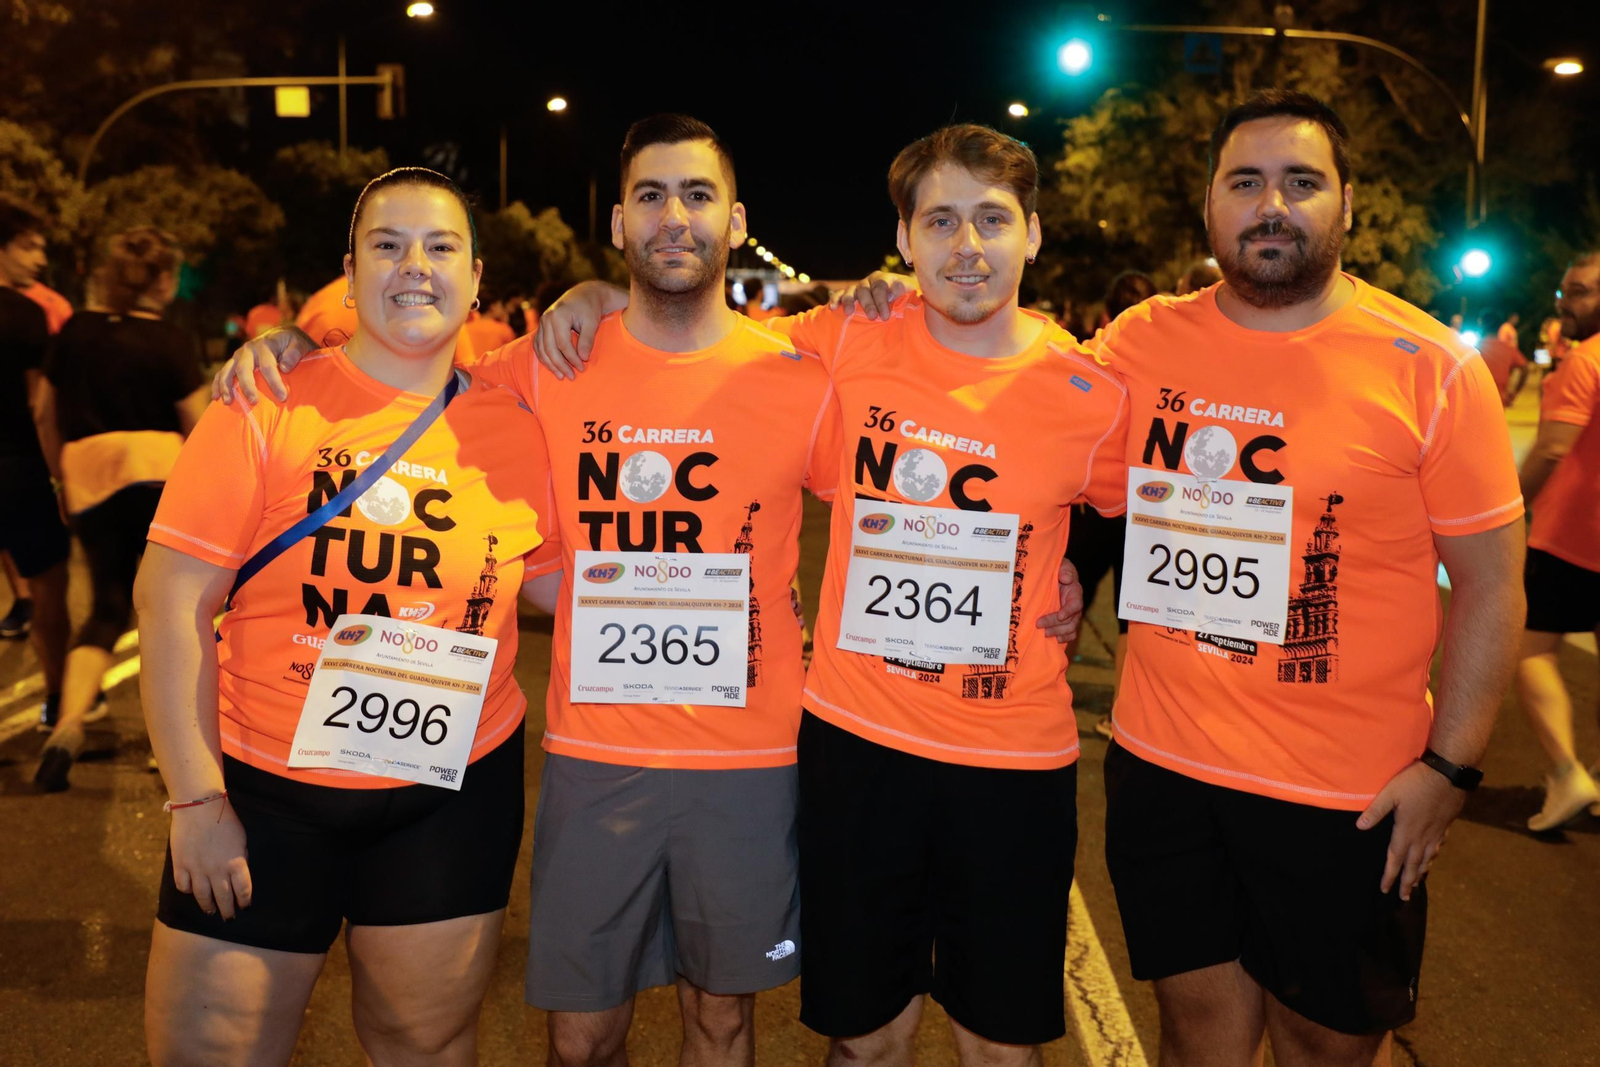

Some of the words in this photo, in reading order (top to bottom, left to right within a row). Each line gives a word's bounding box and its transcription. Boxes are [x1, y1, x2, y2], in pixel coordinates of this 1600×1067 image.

[1156, 388, 1187, 412] 36
[1190, 398, 1284, 427] CARRERA
[582, 420, 612, 443] 36
[618, 425, 714, 443] CARRERA
[864, 406, 896, 432] 36
[900, 420, 996, 459] CARRERA
[317, 448, 351, 468] 36
[356, 450, 448, 485] CRERA
[1150, 519, 1171, 527] CARRERA
[1172, 523, 1198, 532] NOCTURNA
[1210, 529, 1252, 538] GUADALQUIVIR
[307, 526, 443, 588] TUR
[935, 559, 978, 567] GUADALQUIVIR
[1147, 544, 1260, 599] 2995
[865, 575, 982, 626] 2364
[1126, 602, 1159, 613] Cruzcampo
[1251, 620, 1279, 629] POWER
[598, 622, 720, 666] 2365
[846, 633, 876, 644] Cruzcampo
[1210, 636, 1254, 652] septiembre
[972, 646, 1000, 654] POWER
[1198, 643, 1229, 660] SEVILLA
[1230, 654, 1254, 665] 2024
[339, 662, 364, 670] CARRERA
[365, 667, 396, 676] NOCTURNA
[409, 675, 450, 686] GUADALQUIVIR
[886, 664, 916, 679] SEVILLA
[918, 673, 940, 683] 2024
[578, 685, 614, 693] Cruzcampo
[323, 686, 451, 746] 2996
[298, 748, 330, 757] Cruzcampo
[430, 766, 458, 776] POWER
